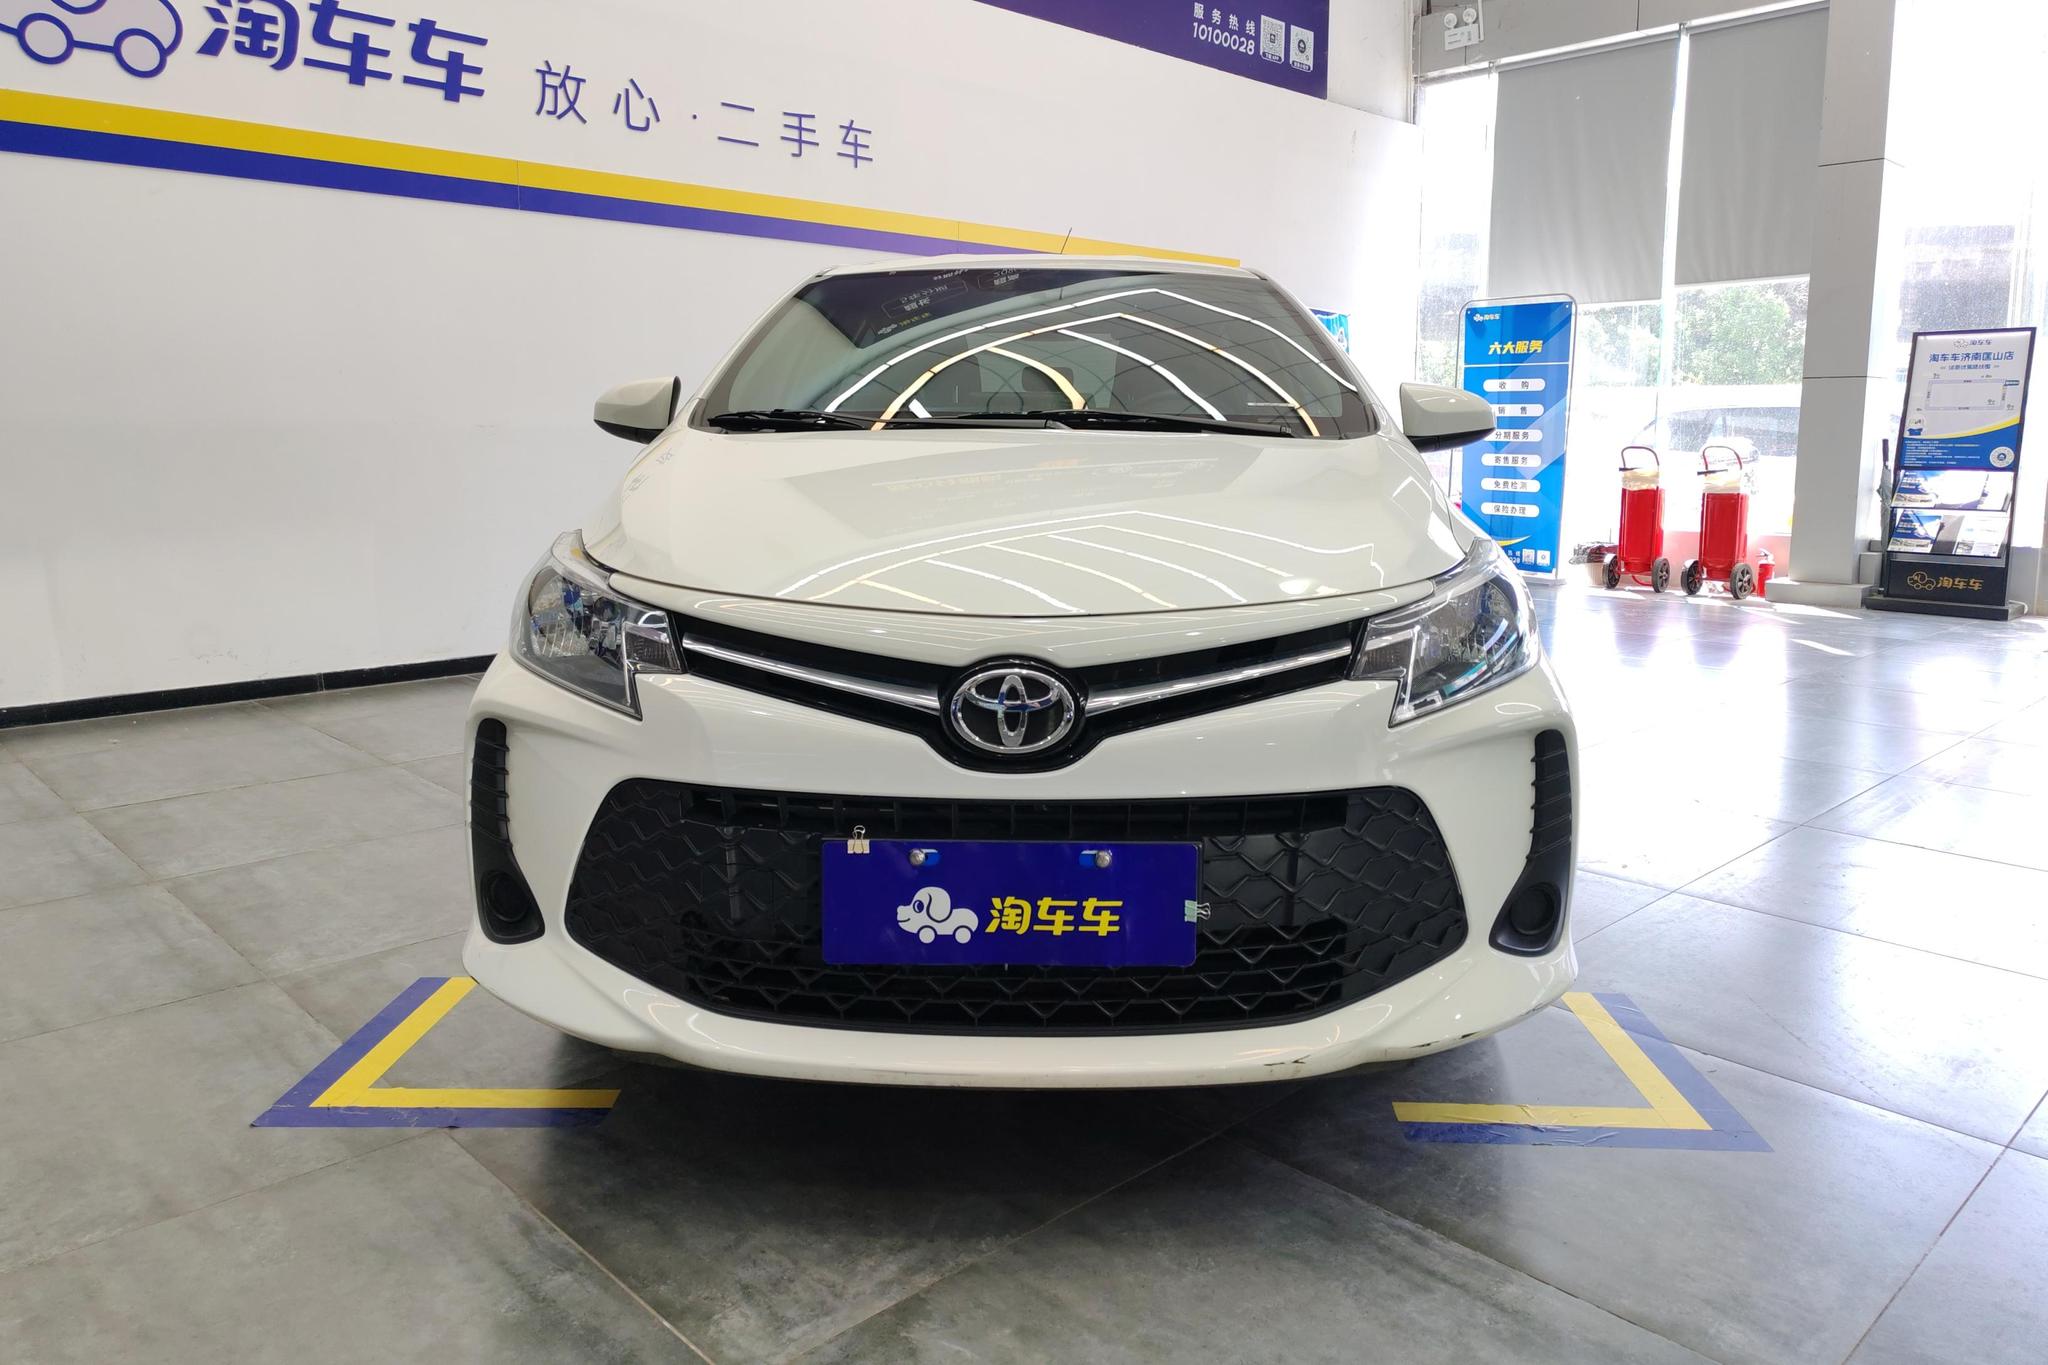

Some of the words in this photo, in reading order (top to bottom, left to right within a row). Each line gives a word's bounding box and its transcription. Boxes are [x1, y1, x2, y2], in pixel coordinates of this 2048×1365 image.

[1193, 2, 1256, 36] 服务热线
[1192, 21, 1256, 56] 10100028
[196, 0, 488, 103] 淘车车
[1488, 340, 1543, 355] 六大服务
[1498, 380, 1530, 390] 收购
[1497, 406, 1528, 415] 销售
[1495, 431, 1529, 440] 分期服务
[1494, 456, 1528, 465] 寄售服务
[1493, 480, 1528, 490] 免费检测
[1493, 504, 1527, 515] 保险办理
[1937, 576, 1985, 591] 淘车车
[985, 896, 1123, 937] 淘车车
